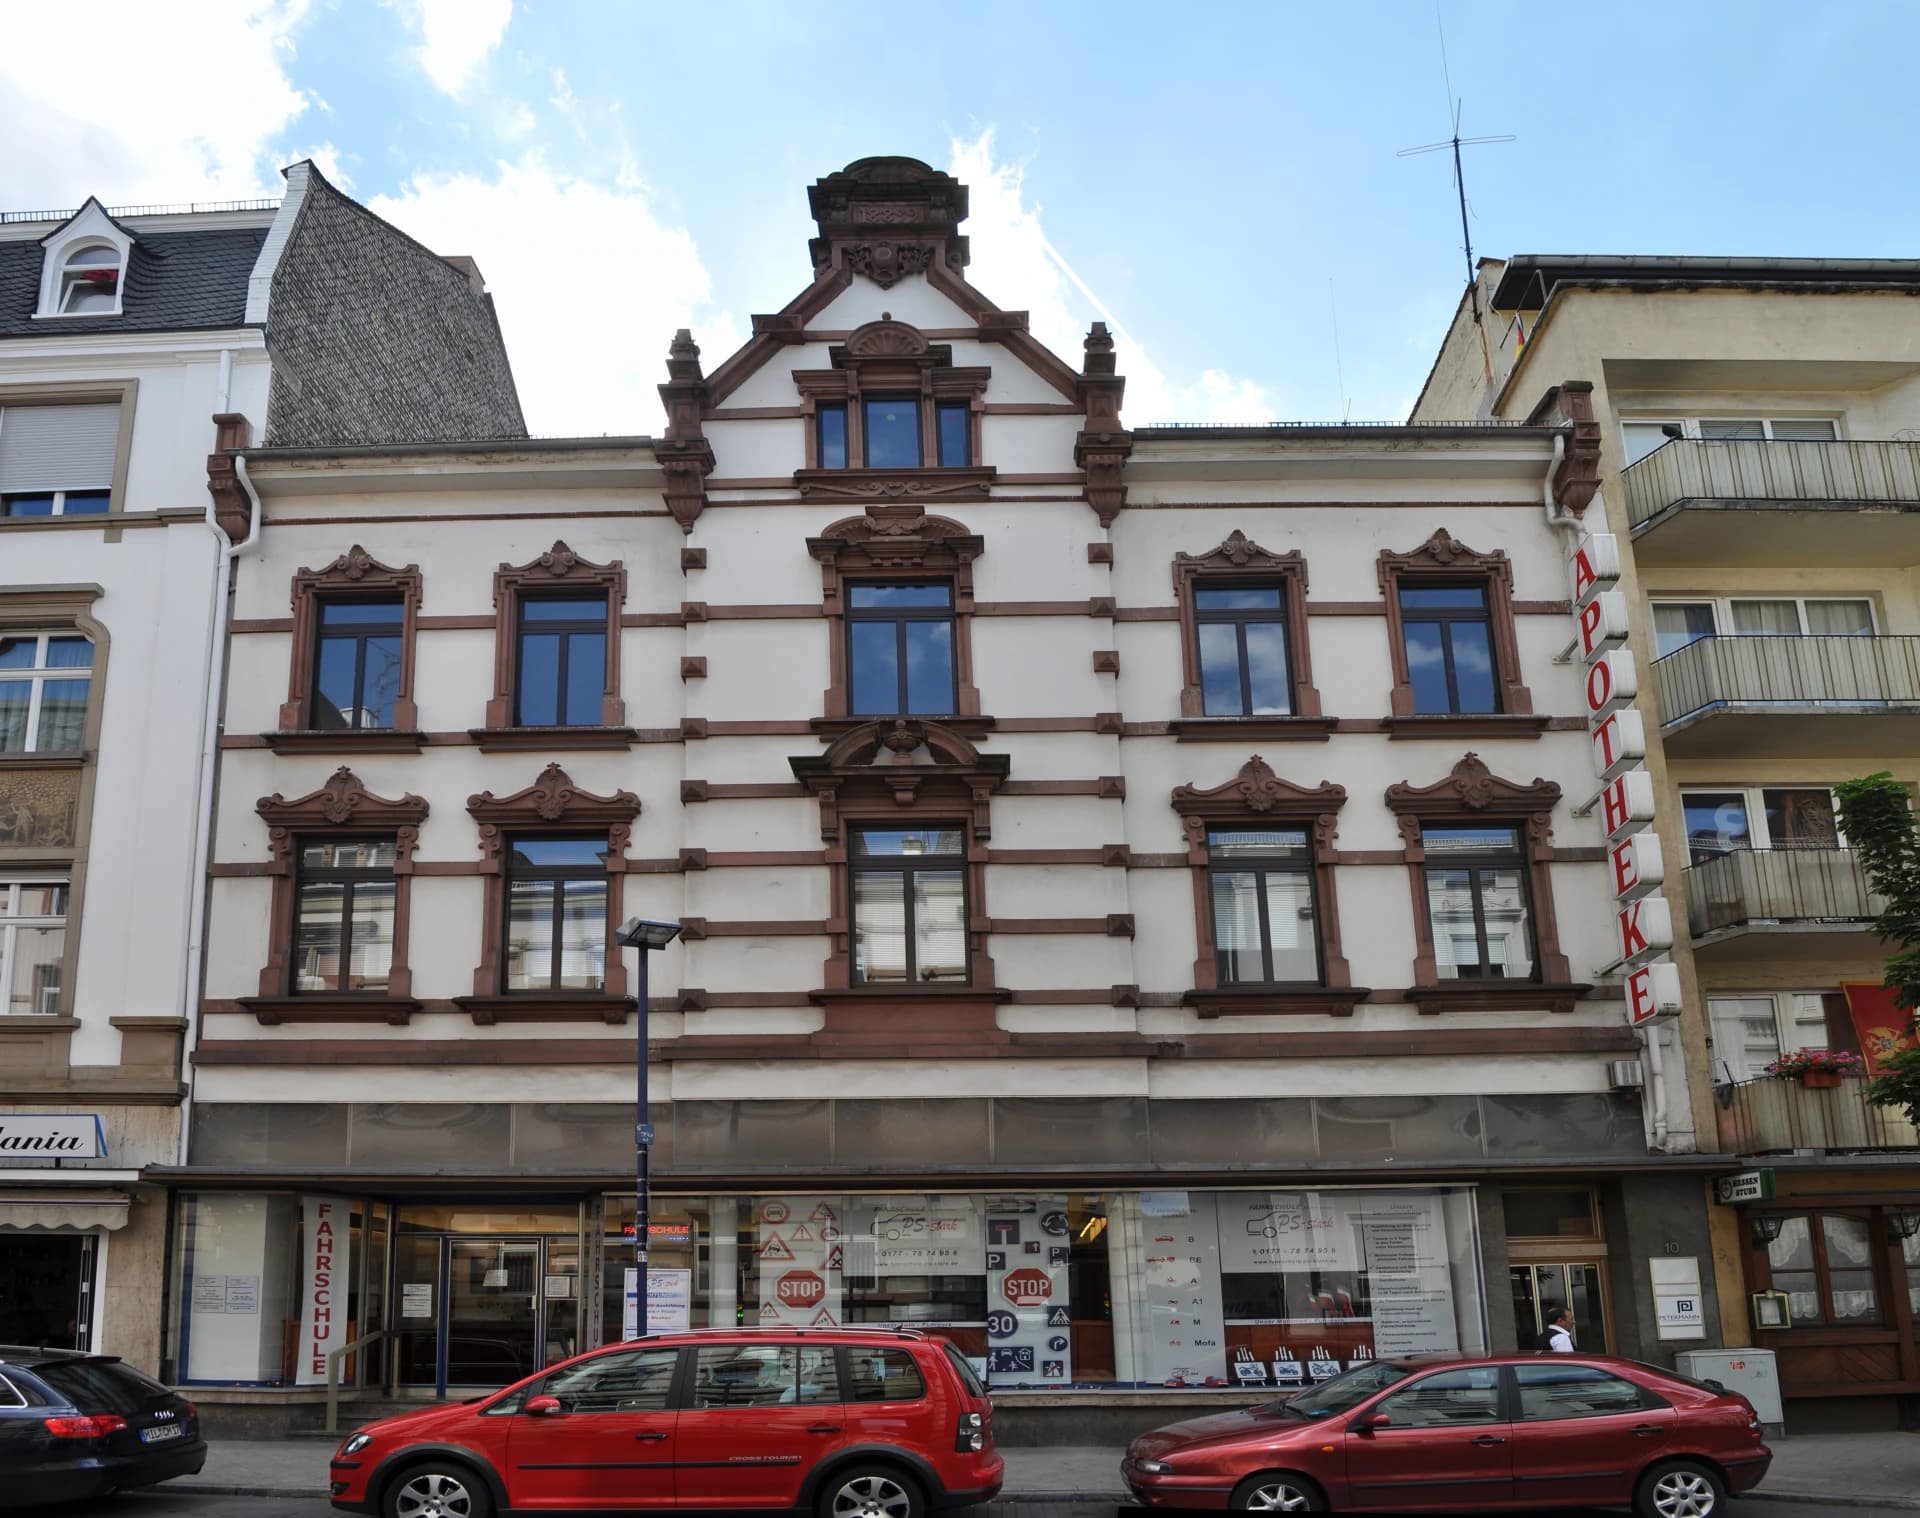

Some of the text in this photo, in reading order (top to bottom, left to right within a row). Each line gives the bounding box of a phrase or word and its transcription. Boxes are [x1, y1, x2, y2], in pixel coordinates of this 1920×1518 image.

[1575, 548, 1655, 1023] APOTHEKE
[624, 1226, 689, 1234] FASCHULE
[1051, 1248, 1060, 1257] P
[1664, 1242, 1679, 1254] 10
[988, 1254, 1000, 1268] P
[312, 1204, 332, 1375] FAHRSCHULE
[780, 1281, 822, 1298] STOP
[1007, 1279, 1049, 1297] STOP
[988, 1316, 1013, 1333] 30
[1194, 1339, 1216, 1347] Mofa
